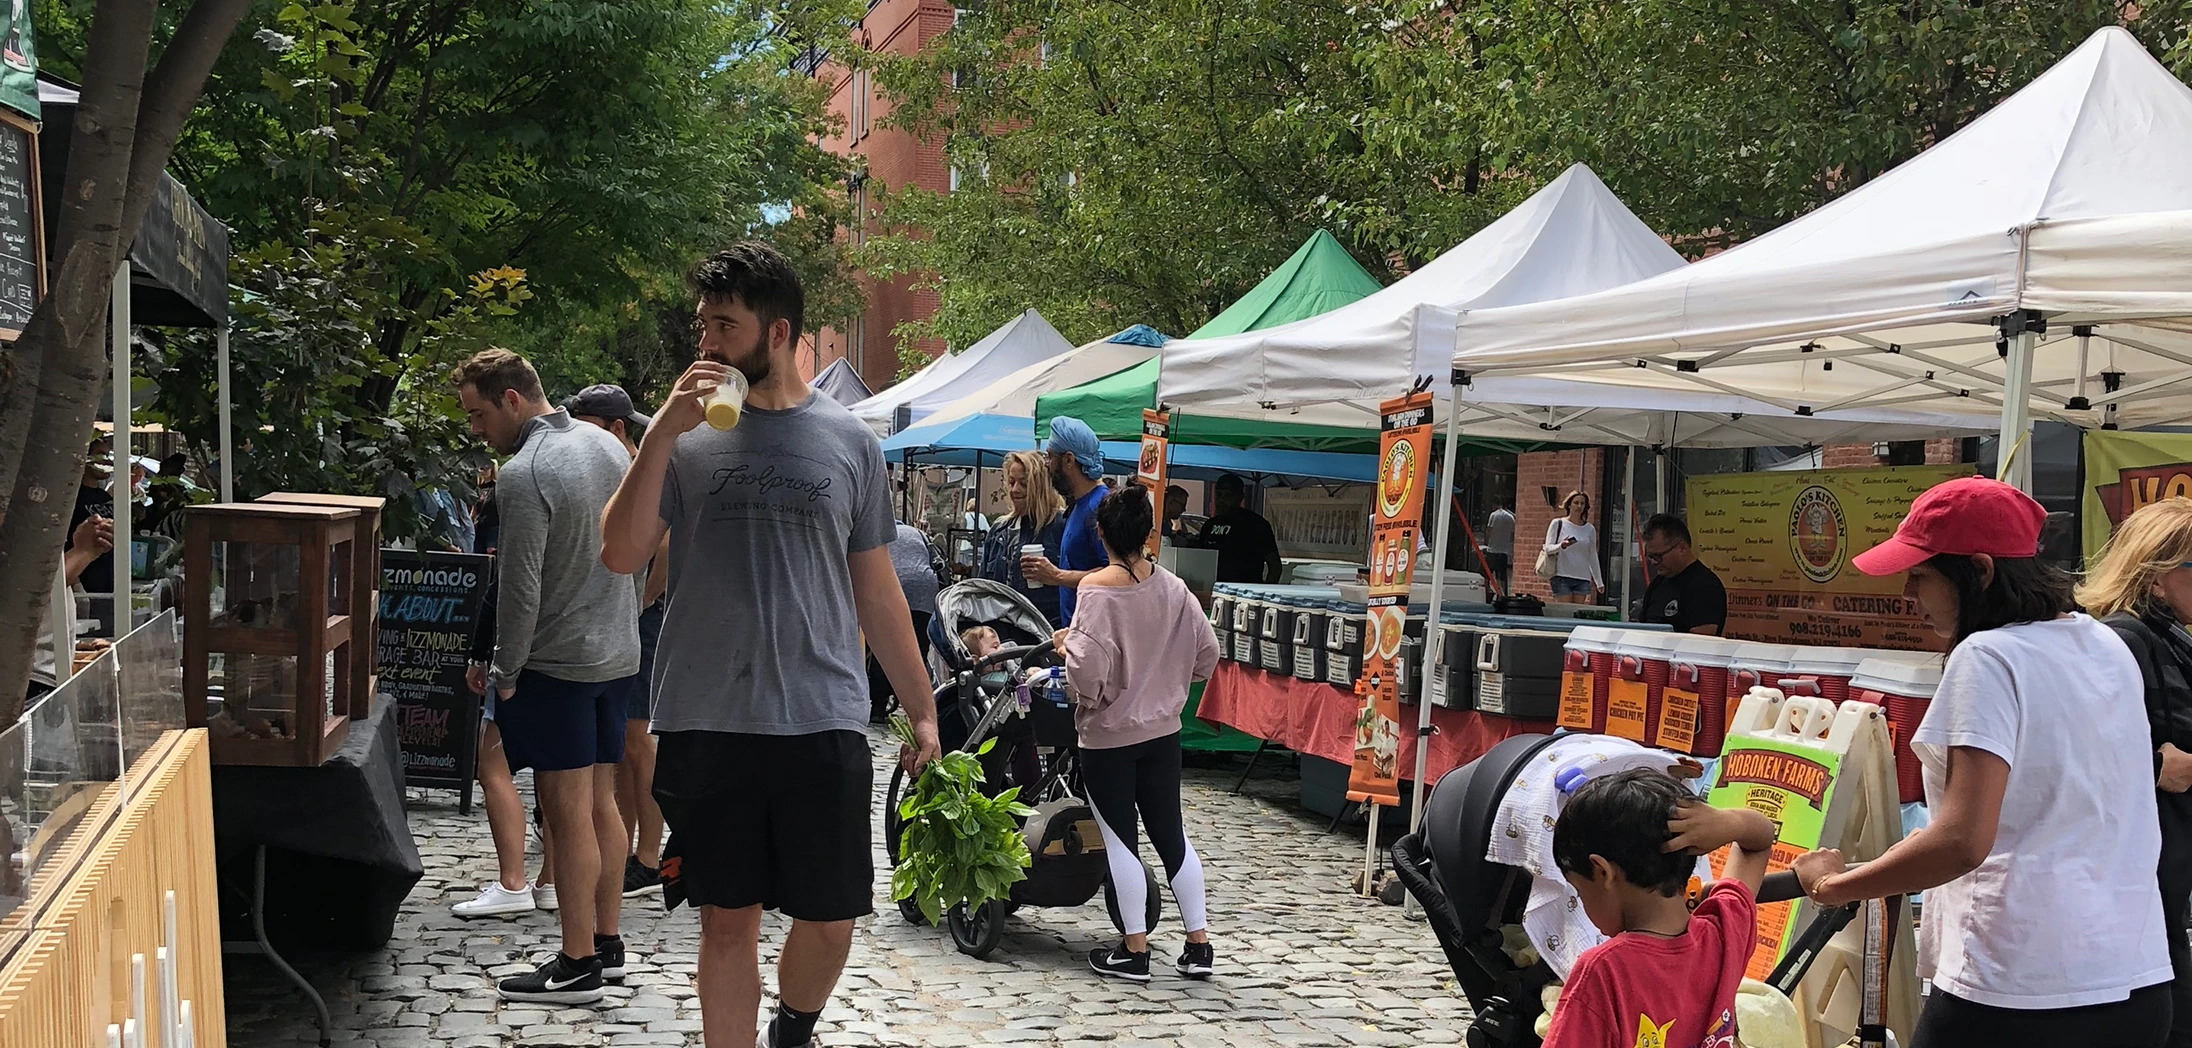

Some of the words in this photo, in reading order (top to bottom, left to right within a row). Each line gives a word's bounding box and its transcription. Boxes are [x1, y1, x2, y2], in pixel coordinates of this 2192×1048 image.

[709, 464, 831, 502] Foolproof
[721, 502, 767, 511] BREWING
[771, 503, 820, 518] COMPANY
[1792, 491, 1814, 537] PAOLO'S
[1815, 491, 1845, 537] KITCHEN
[1728, 592, 1762, 606] Dinners
[1766, 594, 1779, 607] ON
[1781, 594, 1799, 608] THE
[1833, 596, 1902, 615] CATERING
[1789, 621, 1862, 638] 908.219.4166
[411, 649, 441, 668] BAR
[400, 703, 450, 738] TEAM
[1609, 707, 1628, 719] CHICKEN
[1726, 753, 1782, 781] HOBOKEN
[1782, 760, 1824, 795] FARMS
[1749, 788, 1784, 804] HERITAGE
